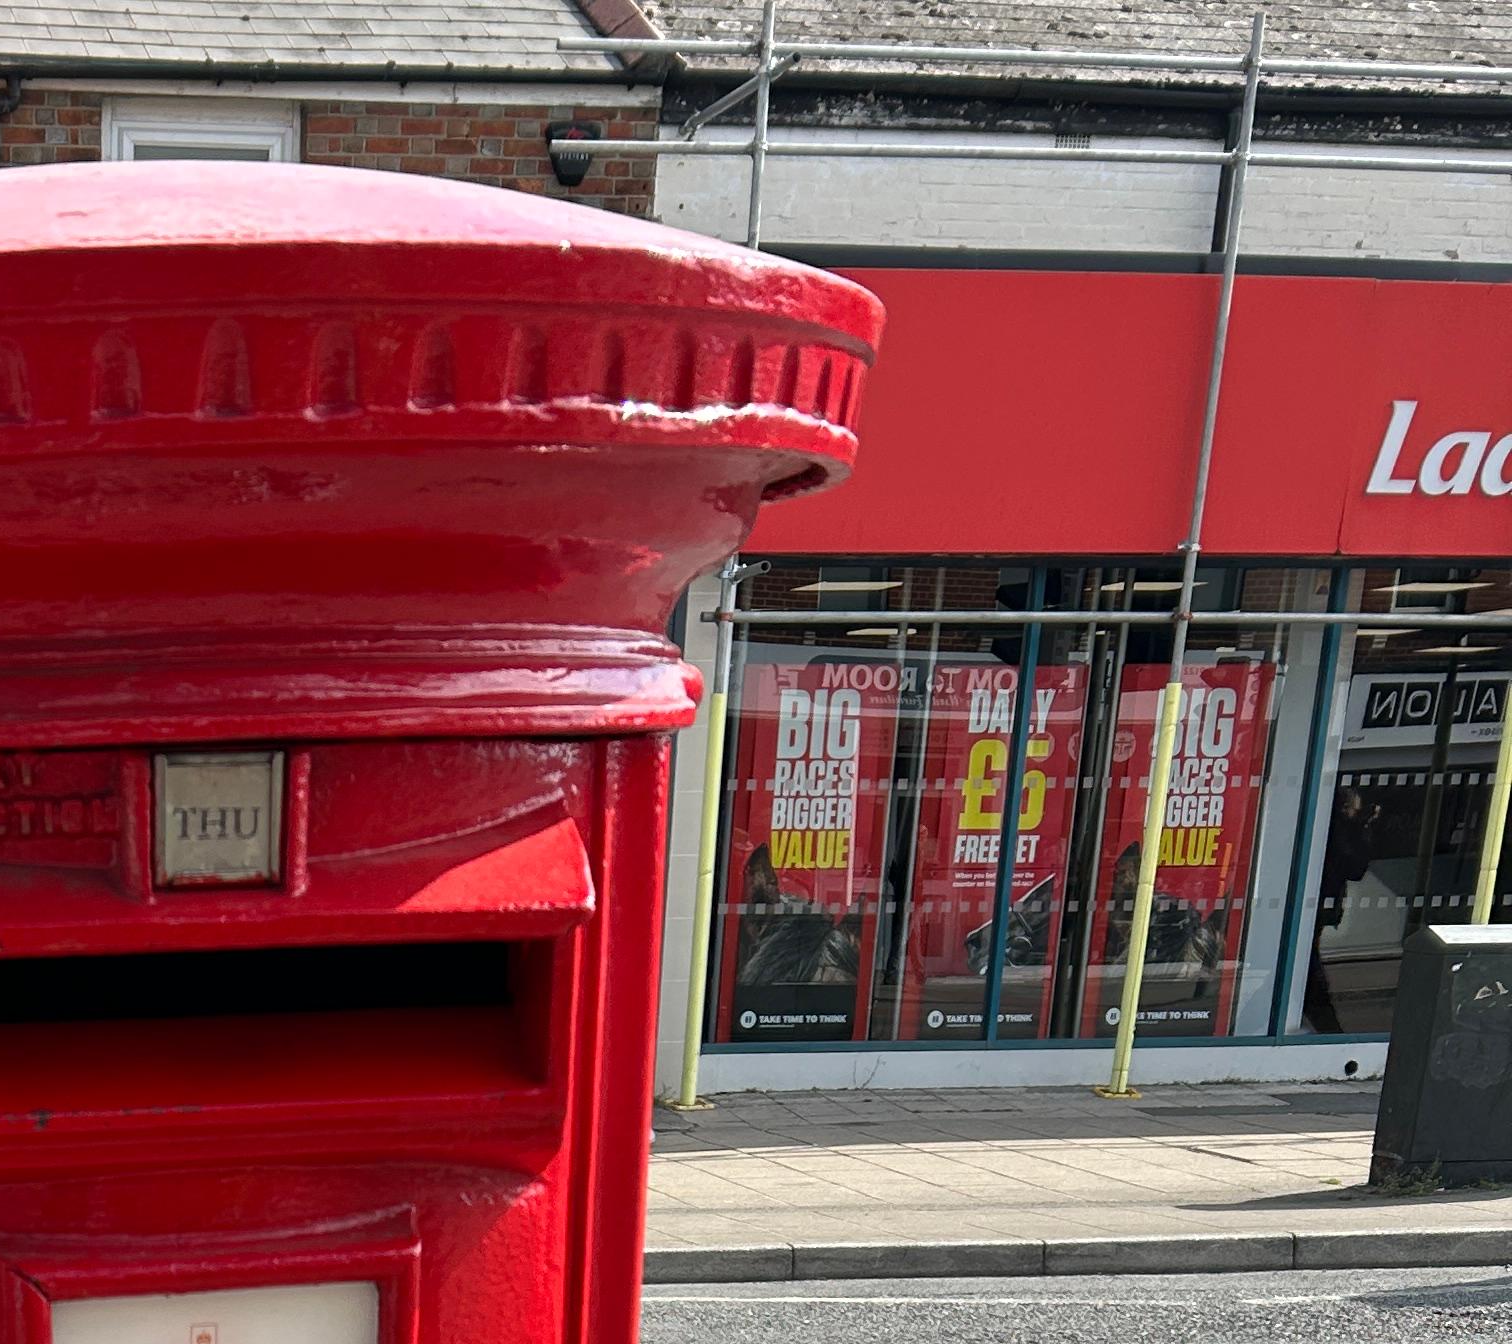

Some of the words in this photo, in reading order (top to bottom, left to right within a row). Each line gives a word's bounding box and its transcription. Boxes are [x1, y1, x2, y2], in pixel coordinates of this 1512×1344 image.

[776, 689, 861, 760] BIG
[968, 688, 1056, 733] DAIY
[774, 760, 856, 797] RACES
[958, 738, 1047, 830] £5
[1148, 758, 1229, 795] ACES
[172, 806, 261, 840] THU
[772, 798, 852, 830] BIGGER
[1144, 796, 1225, 828] GGER
[772, 830, 851, 869] VALUE
[954, 835, 1001, 863] FREE
[1016, 835, 1041, 863] ET
[1158, 828, 1221, 866] ALUE
[759, 1015, 781, 1023] TAKE
[783, 1015, 804, 1023] TIME
[806, 1015, 818, 1023] TO
[819, 1014, 848, 1023] THINK
